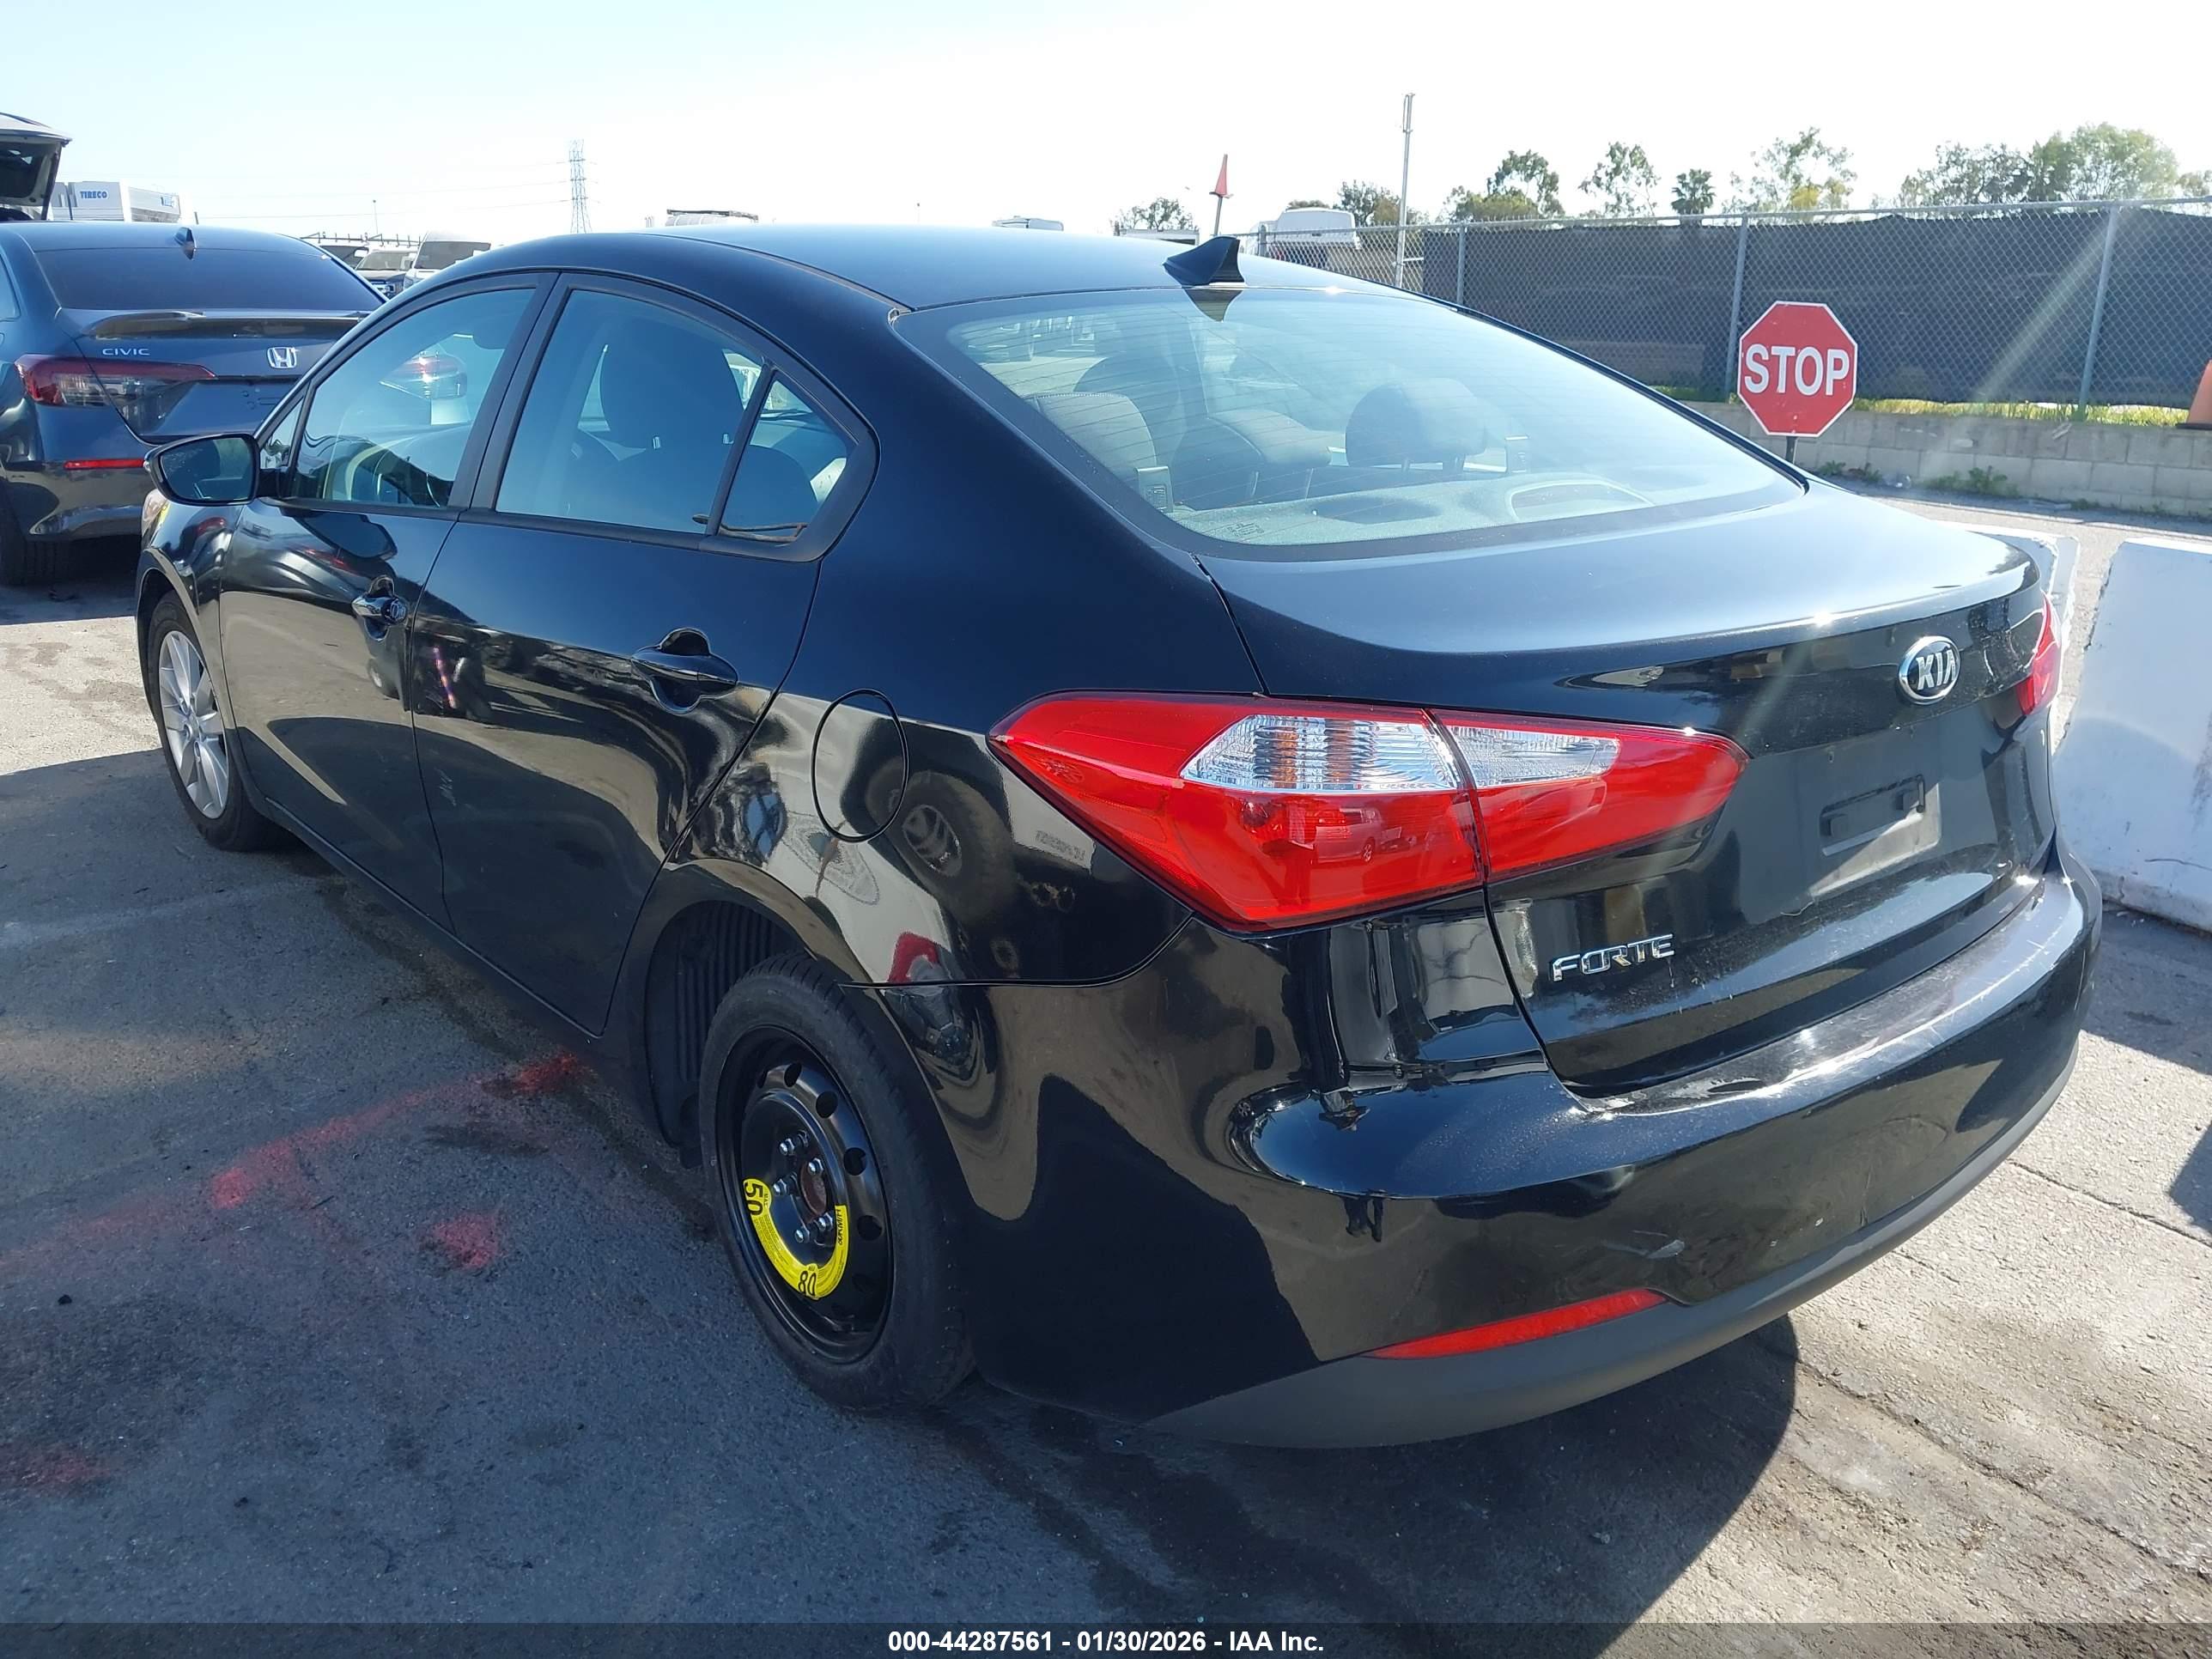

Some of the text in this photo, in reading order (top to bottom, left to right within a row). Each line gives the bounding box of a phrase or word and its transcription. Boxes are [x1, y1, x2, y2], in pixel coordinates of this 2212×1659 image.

[79, 191, 107, 199] TIRECO
[1744, 343, 1850, 396] STOP
[1916, 649, 1956, 690] KIA
[1553, 933, 1675, 982] FORTE
[744, 1182, 763, 1216] 50
[798, 1270, 817, 1297] 80
